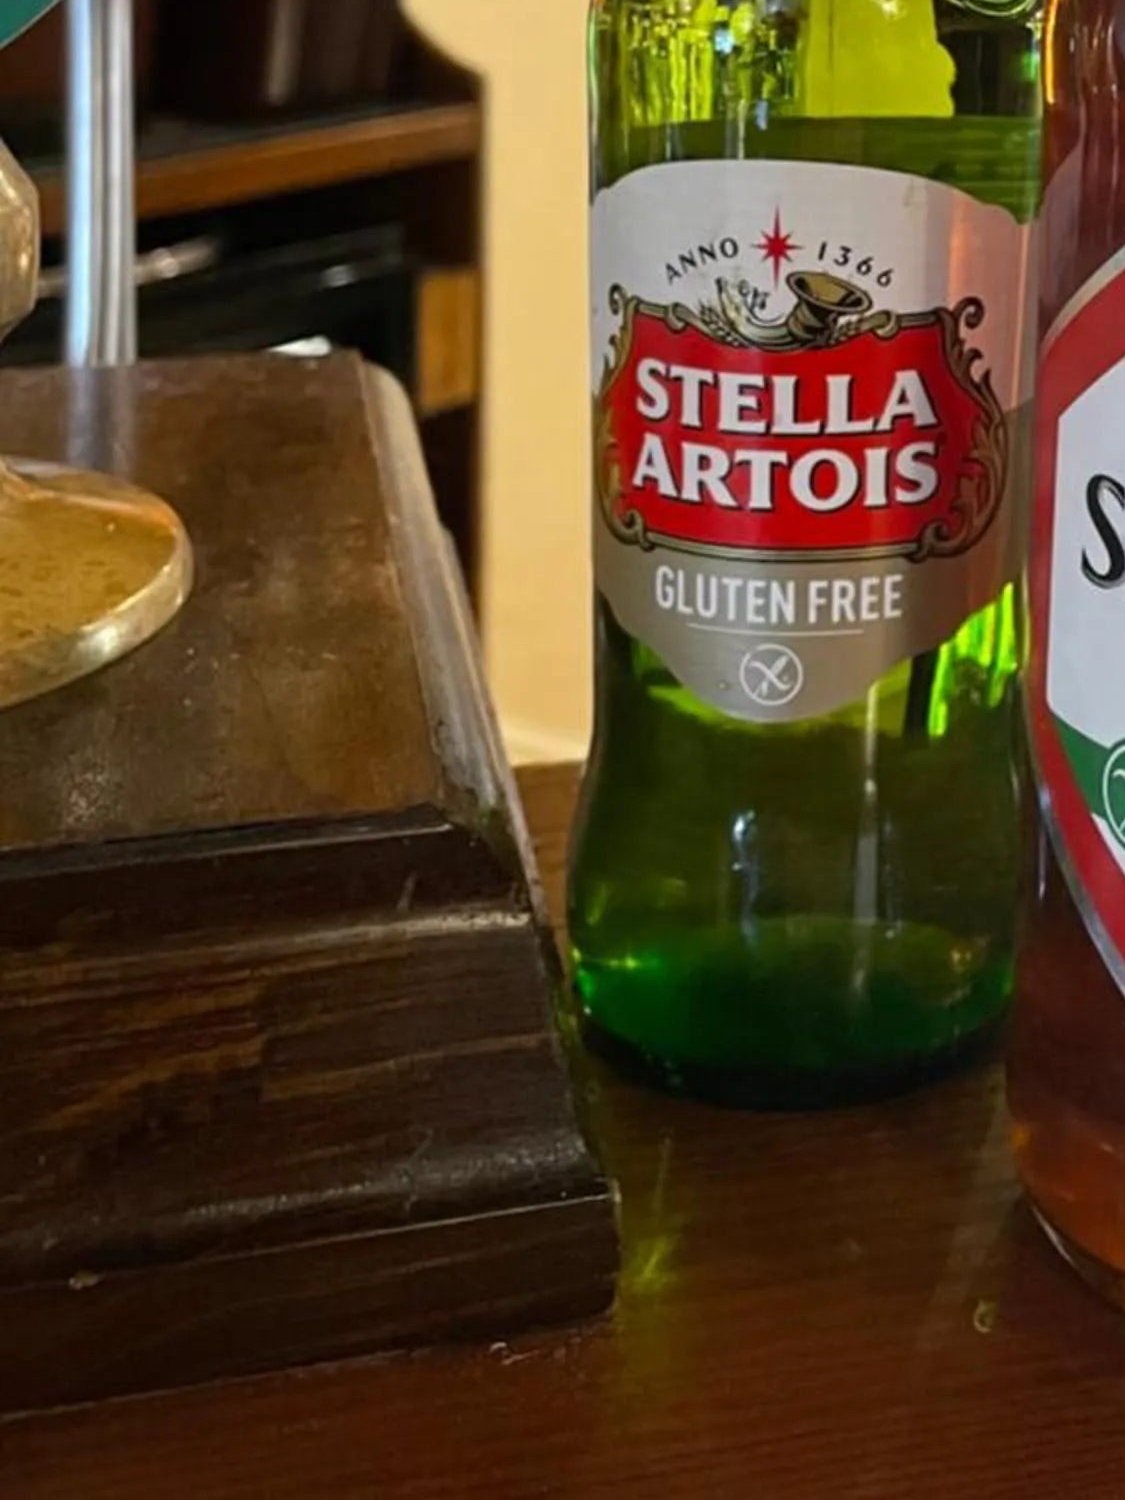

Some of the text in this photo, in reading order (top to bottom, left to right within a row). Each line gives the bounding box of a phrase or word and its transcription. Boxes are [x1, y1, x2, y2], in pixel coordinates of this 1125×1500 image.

[664, 237, 894, 289] ANNO 1366
[634, 356, 939, 436] STELLA
[631, 432, 942, 513] ARTOIS
[654, 565, 904, 625] GLUTEN FREE
